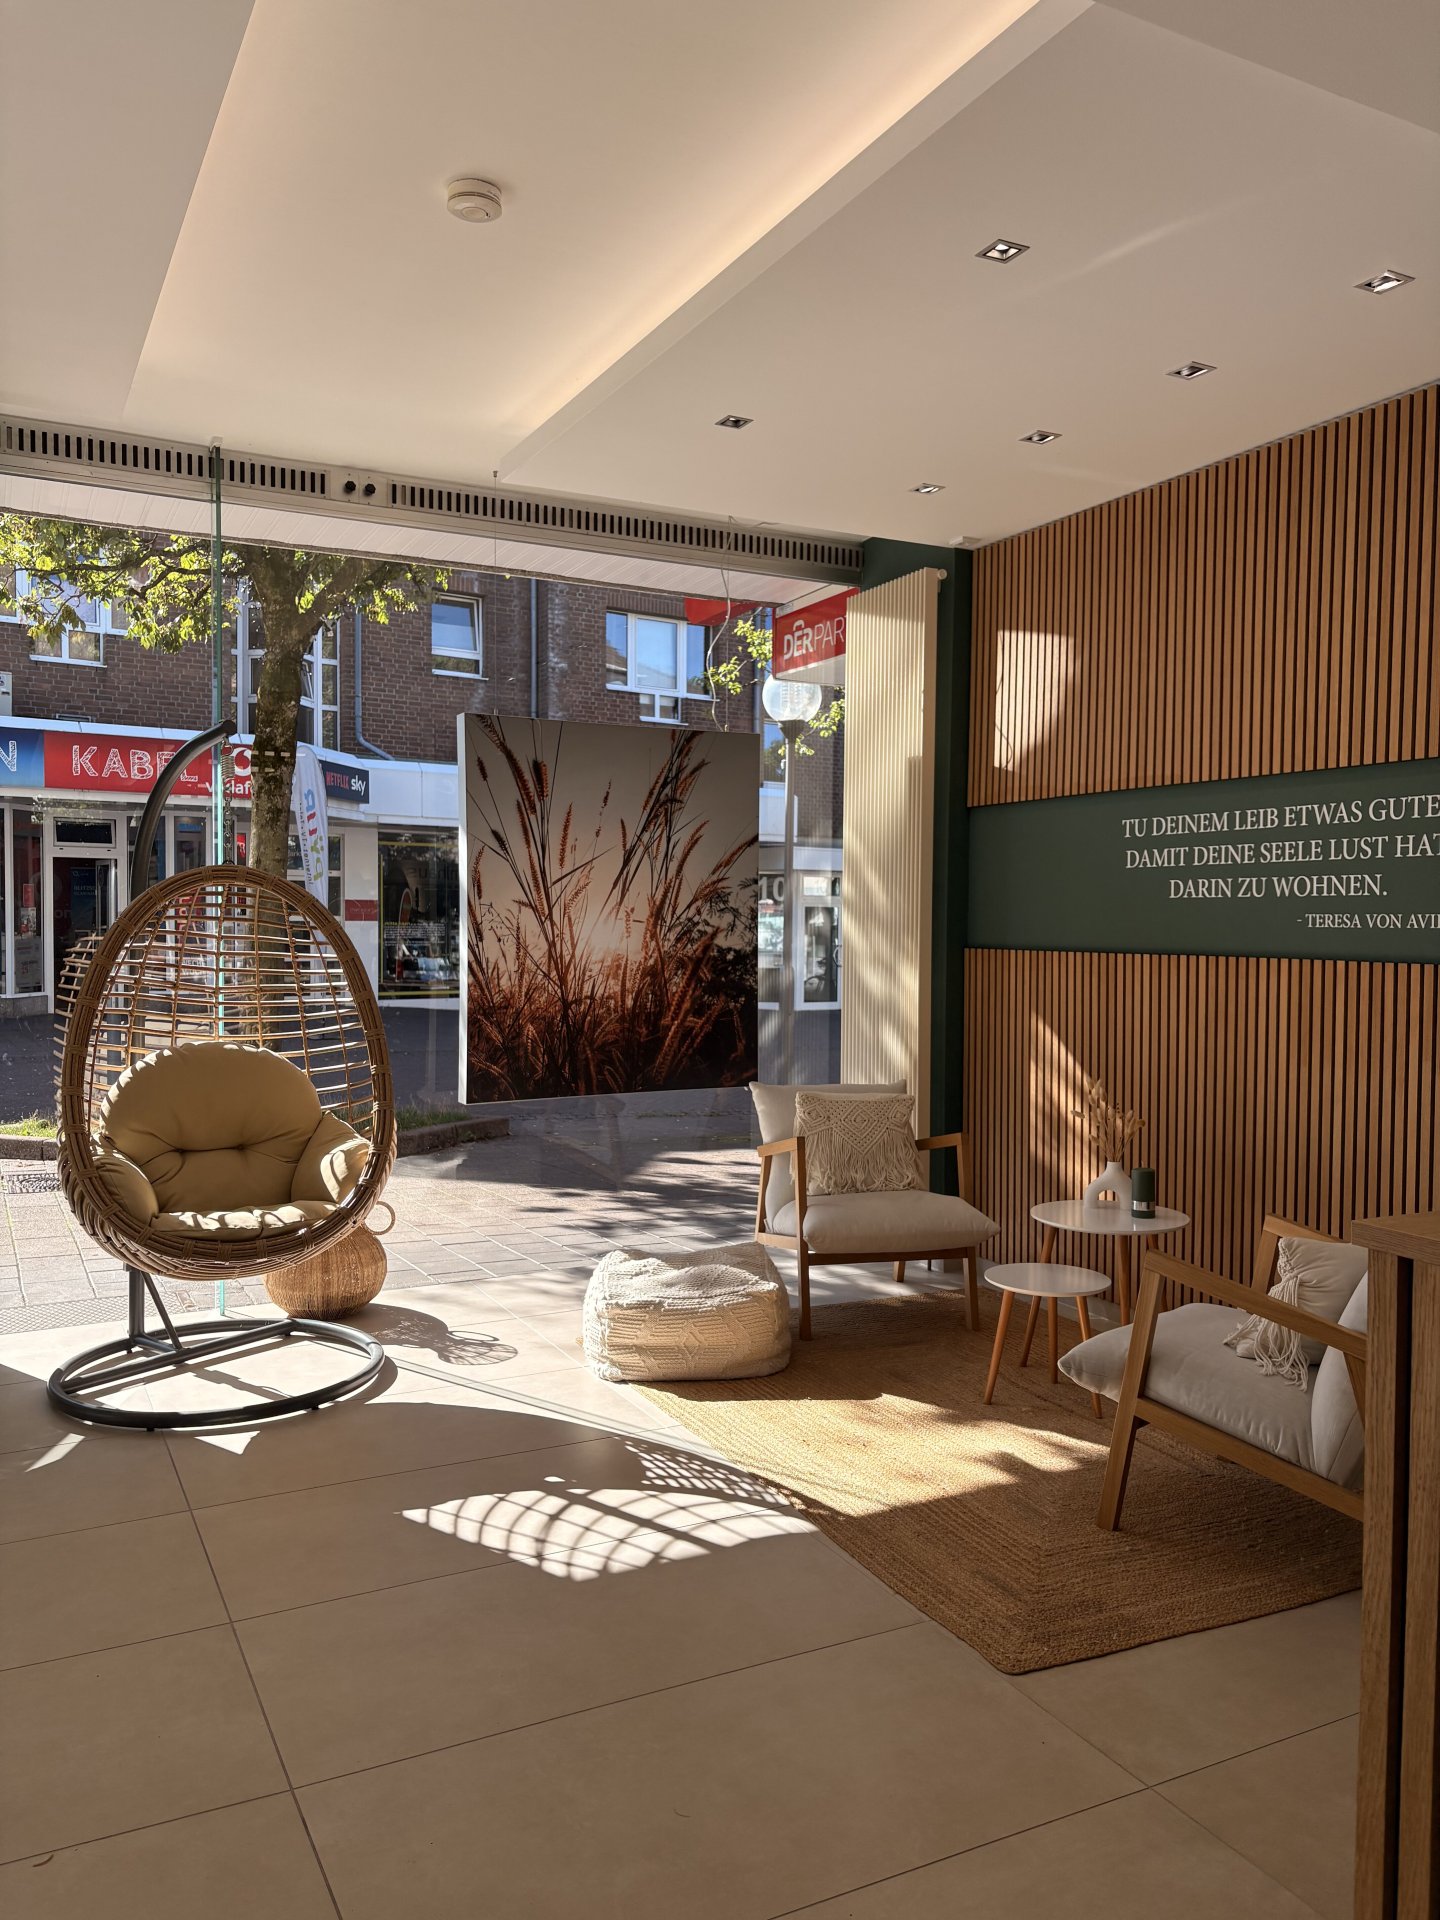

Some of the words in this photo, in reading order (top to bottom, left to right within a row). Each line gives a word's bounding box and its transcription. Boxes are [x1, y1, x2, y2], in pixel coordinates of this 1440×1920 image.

[784, 616, 847, 660] DERPAR
[205, 779, 252, 795] vaf
[326, 772, 349, 790] NETFLIX
[351, 774, 366, 797] sky
[1122, 818, 1148, 838] TU
[1152, 811, 1230, 836] DEINEM
[1234, 807, 1279, 831] LEIB
[1284, 800, 1363, 827] ETWAS
[1125, 847, 1188, 869] DAMIT
[1193, 843, 1255, 866] DEINE
[1260, 839, 1323, 864] SEELE
[1328, 835, 1389, 861] LUST
[1169, 878, 1233, 899] DARIN
[1237, 877, 1267, 898] ZU
[1272, 873, 1388, 898] WOHNEN.
[1305, 913, 1362, 929] TERESA
[1366, 913, 1403, 929] VON
